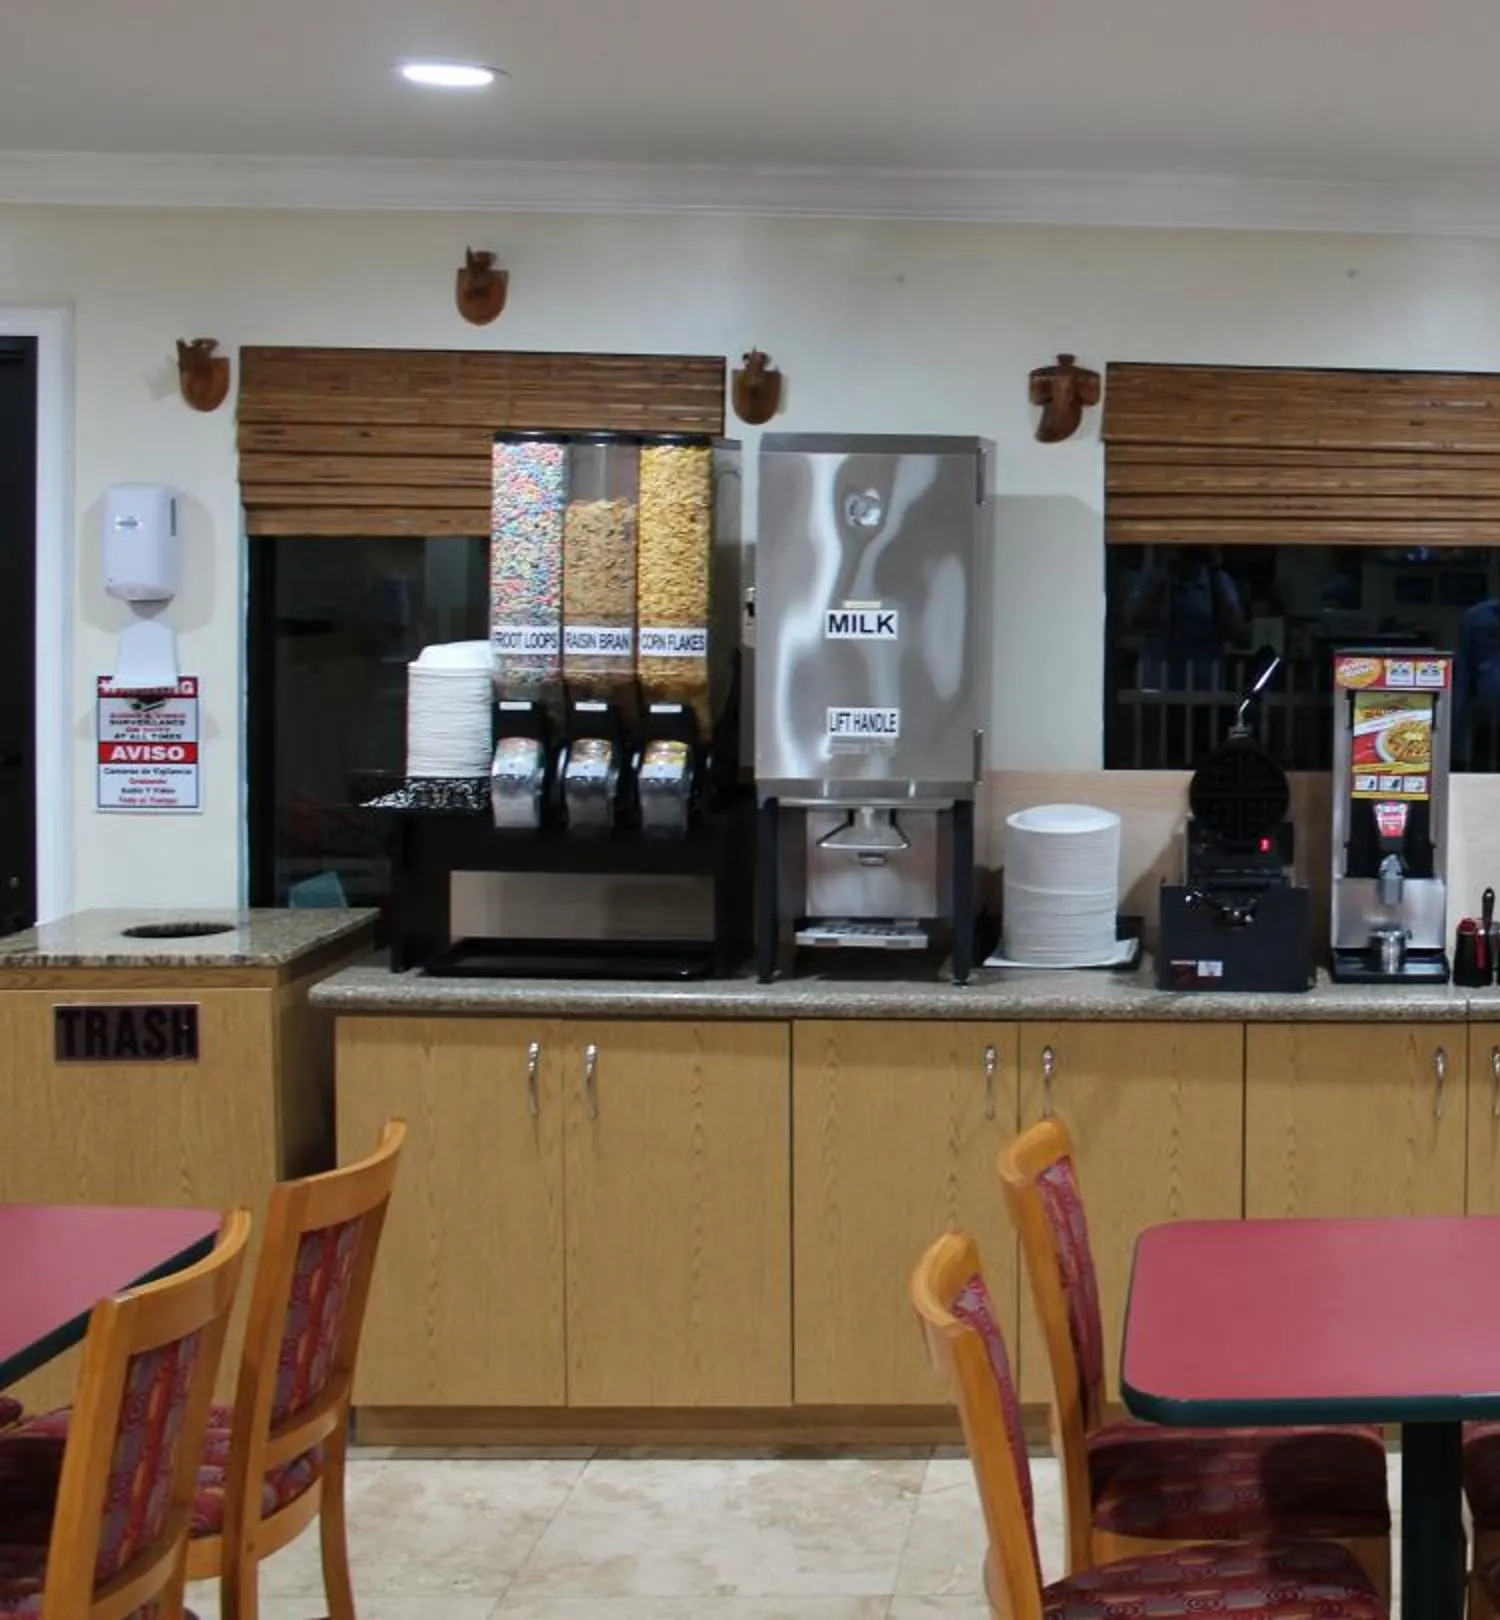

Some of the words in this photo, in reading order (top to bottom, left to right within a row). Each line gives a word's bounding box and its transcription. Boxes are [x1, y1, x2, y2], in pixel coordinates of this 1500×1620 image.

[828, 613, 895, 634] MILK
[524, 631, 558, 649] LOOPS
[564, 631, 597, 649] RAISIN
[599, 632, 630, 649] BRAN
[641, 633, 666, 650] CORN
[667, 633, 705, 651] FLAKES
[830, 712, 851, 732] LIFT
[853, 712, 896, 733] HANDLE
[111, 745, 185, 761] AVISO
[56, 1008, 196, 1057] TRASH
